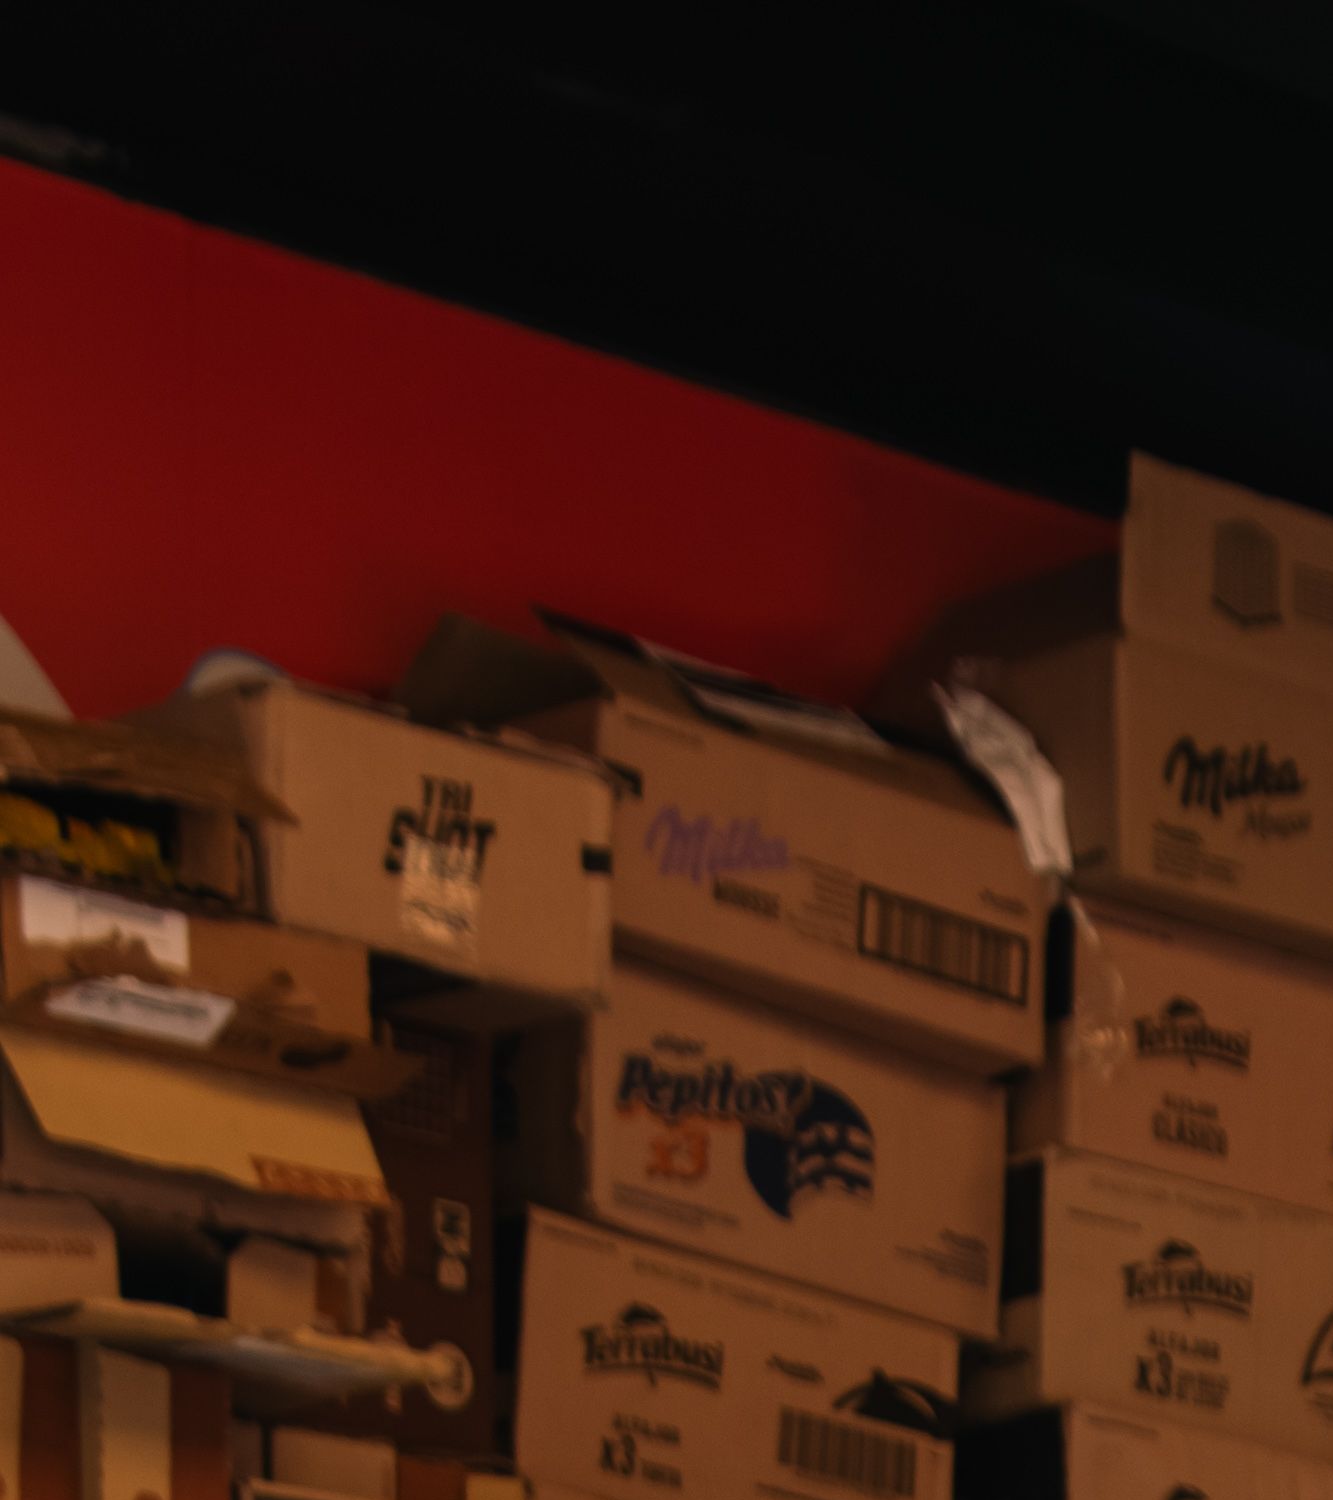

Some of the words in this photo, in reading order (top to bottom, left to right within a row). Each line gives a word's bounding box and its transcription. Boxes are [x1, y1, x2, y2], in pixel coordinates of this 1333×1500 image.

[1166, 736, 1306, 816] Milka
[1121, 1258, 1254, 1318] Terrabusi
[580, 1320, 725, 1390] Terrabusi
